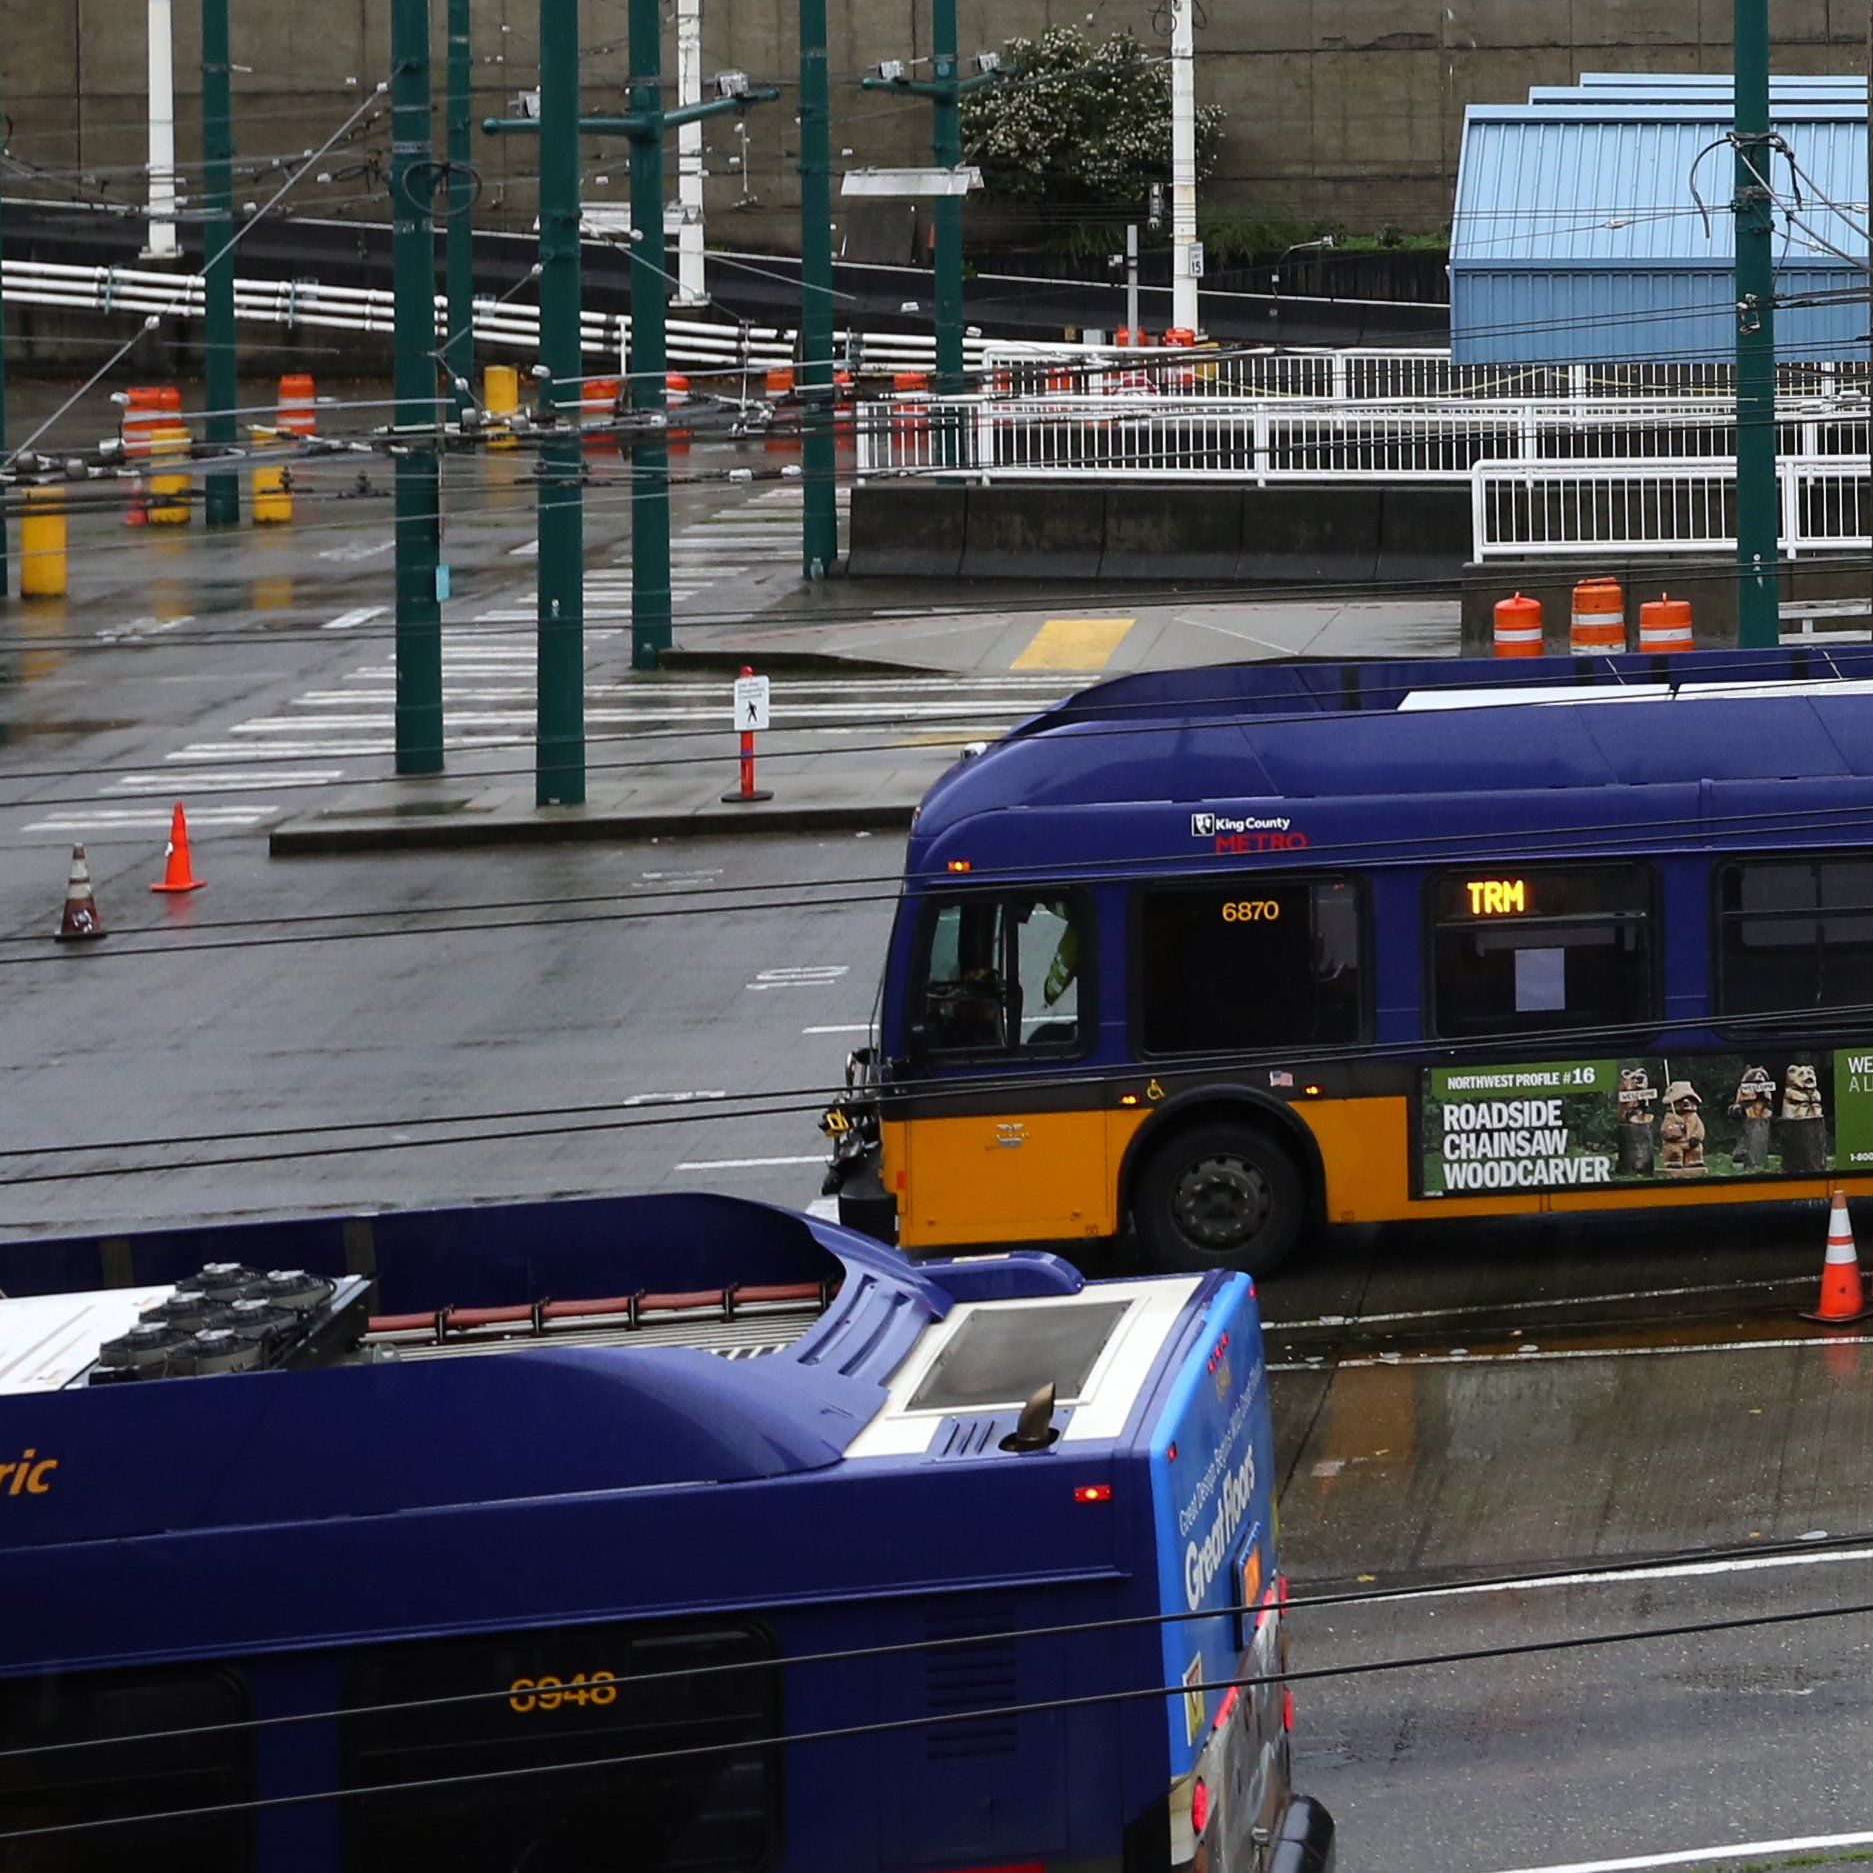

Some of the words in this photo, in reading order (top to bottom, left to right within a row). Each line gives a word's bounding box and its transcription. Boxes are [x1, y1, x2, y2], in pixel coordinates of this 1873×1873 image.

[1215, 818, 1244, 833] King
[1245, 817, 1290, 831] County
[1215, 831, 1309, 855] METRO
[1467, 880, 1524, 914] TRM
[1222, 900, 1280, 922] 6870
[1448, 1074, 1514, 1090] NORTHWEST
[1515, 1072, 1560, 1087] PROFILE
[1563, 1067, 1595, 1085] #16
[1849, 1075, 1860, 1093] A
[1443, 1100, 1563, 1131] ROADSIDE
[1443, 1128, 1568, 1160] CHAINSAW
[1443, 1156, 1611, 1190] WOODCARVER
[1185, 1497, 1225, 1611] Great
